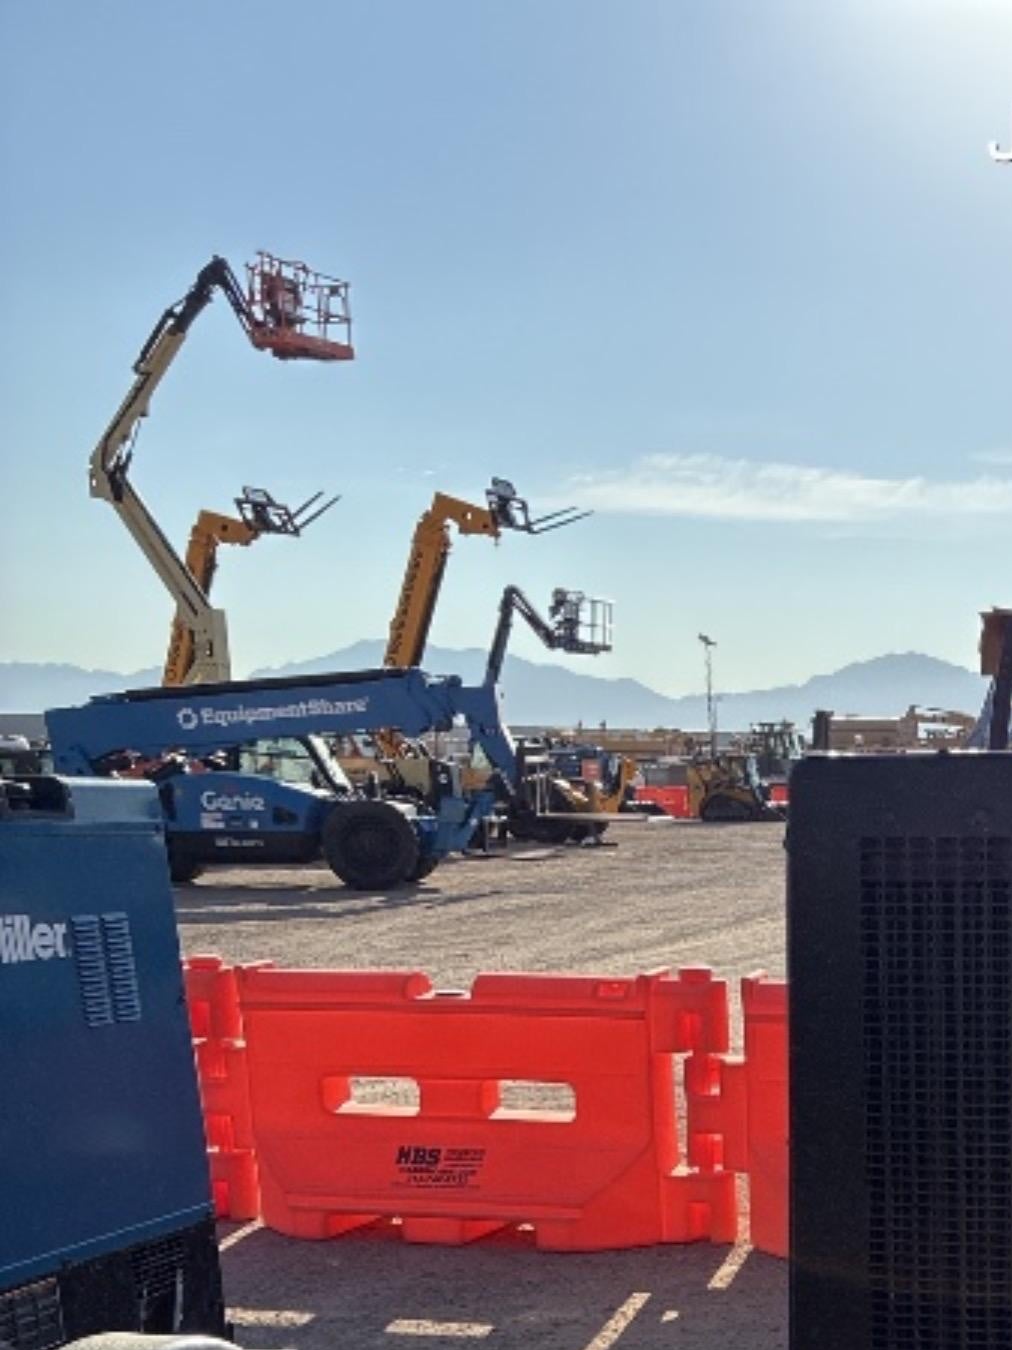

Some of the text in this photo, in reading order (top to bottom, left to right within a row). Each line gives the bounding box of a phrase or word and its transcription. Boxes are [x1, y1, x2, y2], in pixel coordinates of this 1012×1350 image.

[200, 699, 367, 727] EquipmentShare
[201, 791, 265, 812] Genie
[0, 914, 67, 964] iller
[395, 1146, 442, 1165] HBS
